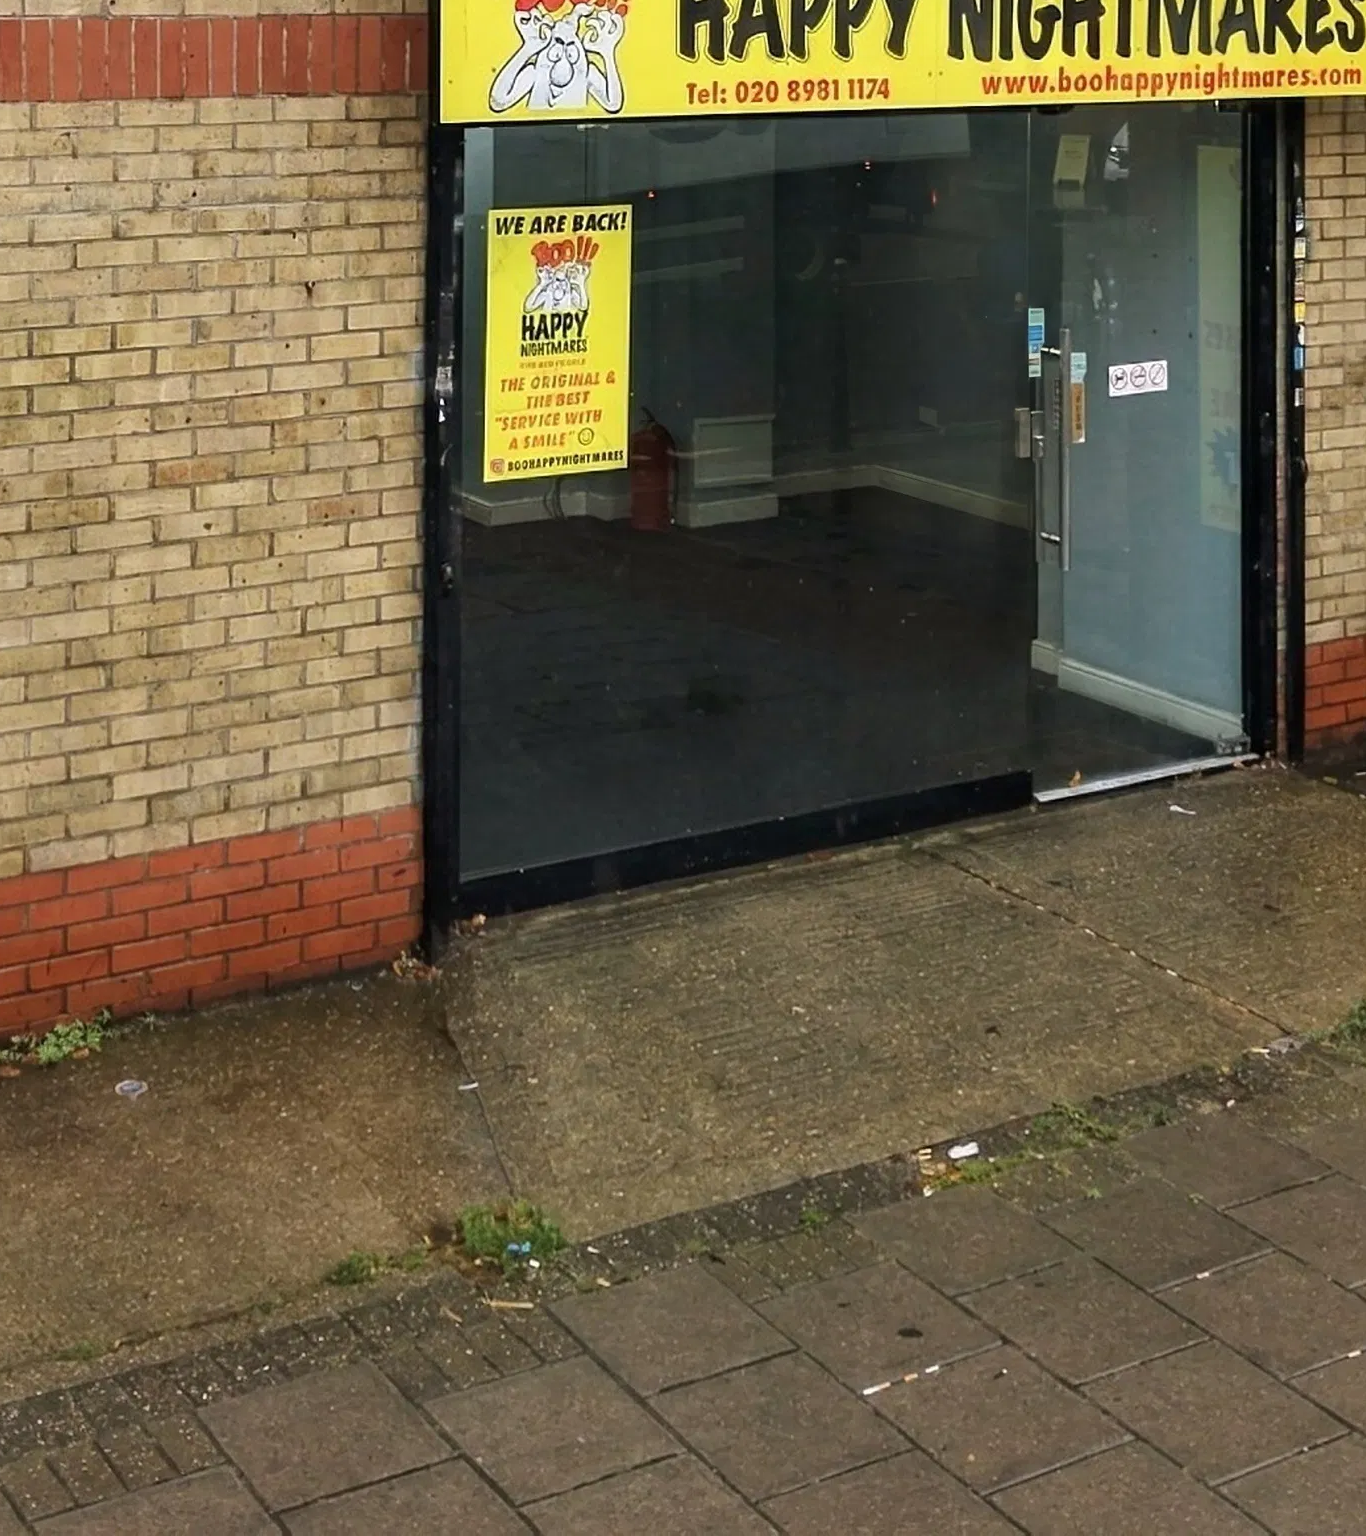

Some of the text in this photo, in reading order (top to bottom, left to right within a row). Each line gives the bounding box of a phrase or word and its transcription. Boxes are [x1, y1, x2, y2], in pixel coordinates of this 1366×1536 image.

[686, 78, 890, 104] Tel: 020 8981 1174
[981, 63, 1363, 97] www.boohappynightmares.com
[496, 211, 627, 235] WE ARE BACK!
[531, 236, 599, 267] BOO!!!
[521, 312, 588, 341] HAPPY
[520, 339, 588, 357] NIGHTMARES
[500, 370, 616, 392] THE ORIGINAL &
[526, 391, 590, 409] THE BEST
[565, 409, 603, 425] WITH
[508, 437, 518, 450] A
[508, 450, 624, 471] BOOHAPPYNIGHTMARES
